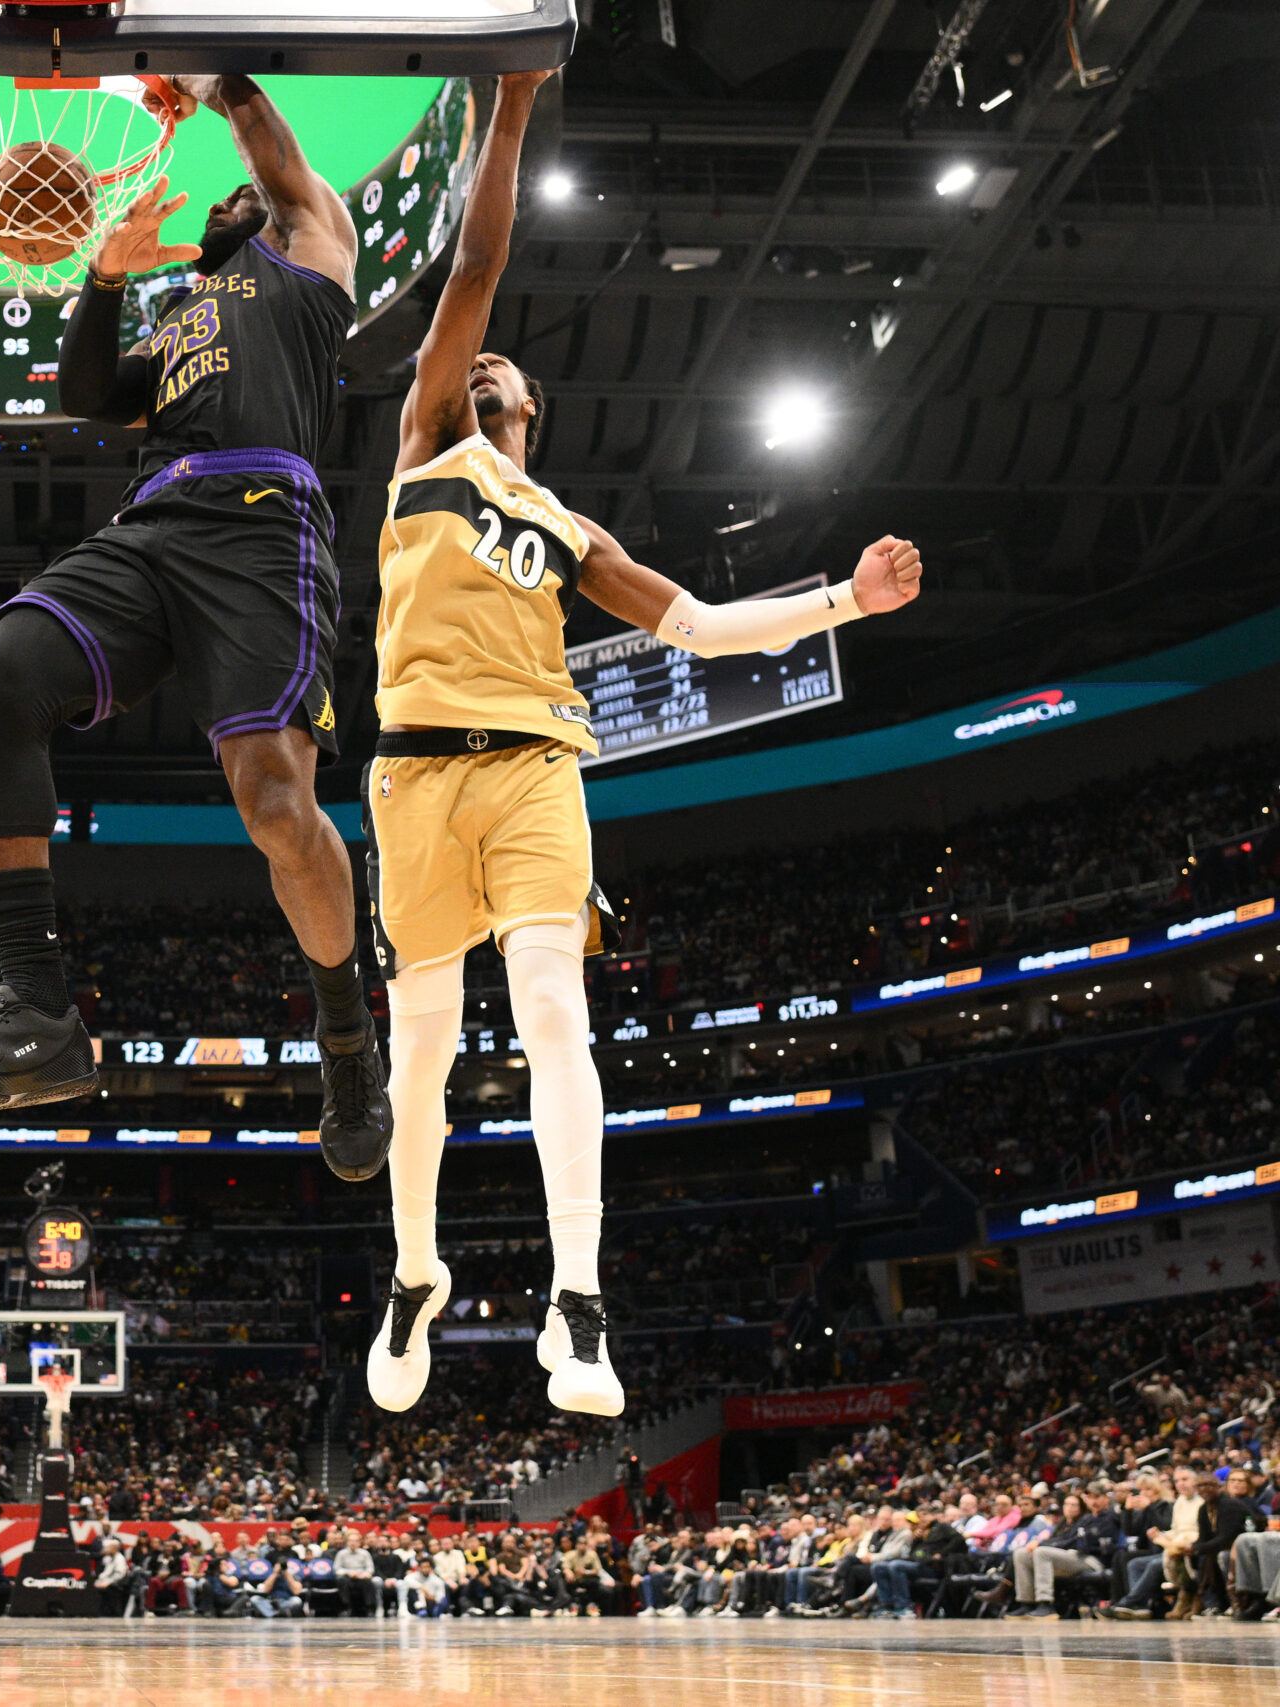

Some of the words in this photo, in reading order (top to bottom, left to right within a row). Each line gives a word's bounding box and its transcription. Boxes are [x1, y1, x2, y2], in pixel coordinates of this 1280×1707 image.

[364, 220, 384, 247] 95
[3, 338, 29, 355] 95
[150, 298, 221, 386] 23
[156, 347, 230, 413] LAKERS
[5, 399, 45, 415] 6:40
[466, 453, 569, 537] Washington
[471, 507, 546, 590] 20
[567, 651, 593, 671] ME
[668, 662, 690, 679] 40
[671, 679, 692, 697] 34
[659, 692, 706, 716] 45/73
[13, 1042, 38, 1058] DUKE
[121, 1041, 165, 1063] 123
[479, 1040, 495, 1052] 34
[45, 1222, 81, 1240] 6:40
[1059, 1234, 1143, 1267] VAULTS
[46, 1280, 86, 1289] TISSOT
[751, 1399, 841, 1421] Hennessy
[845, 1391, 891, 1418] Lofts
